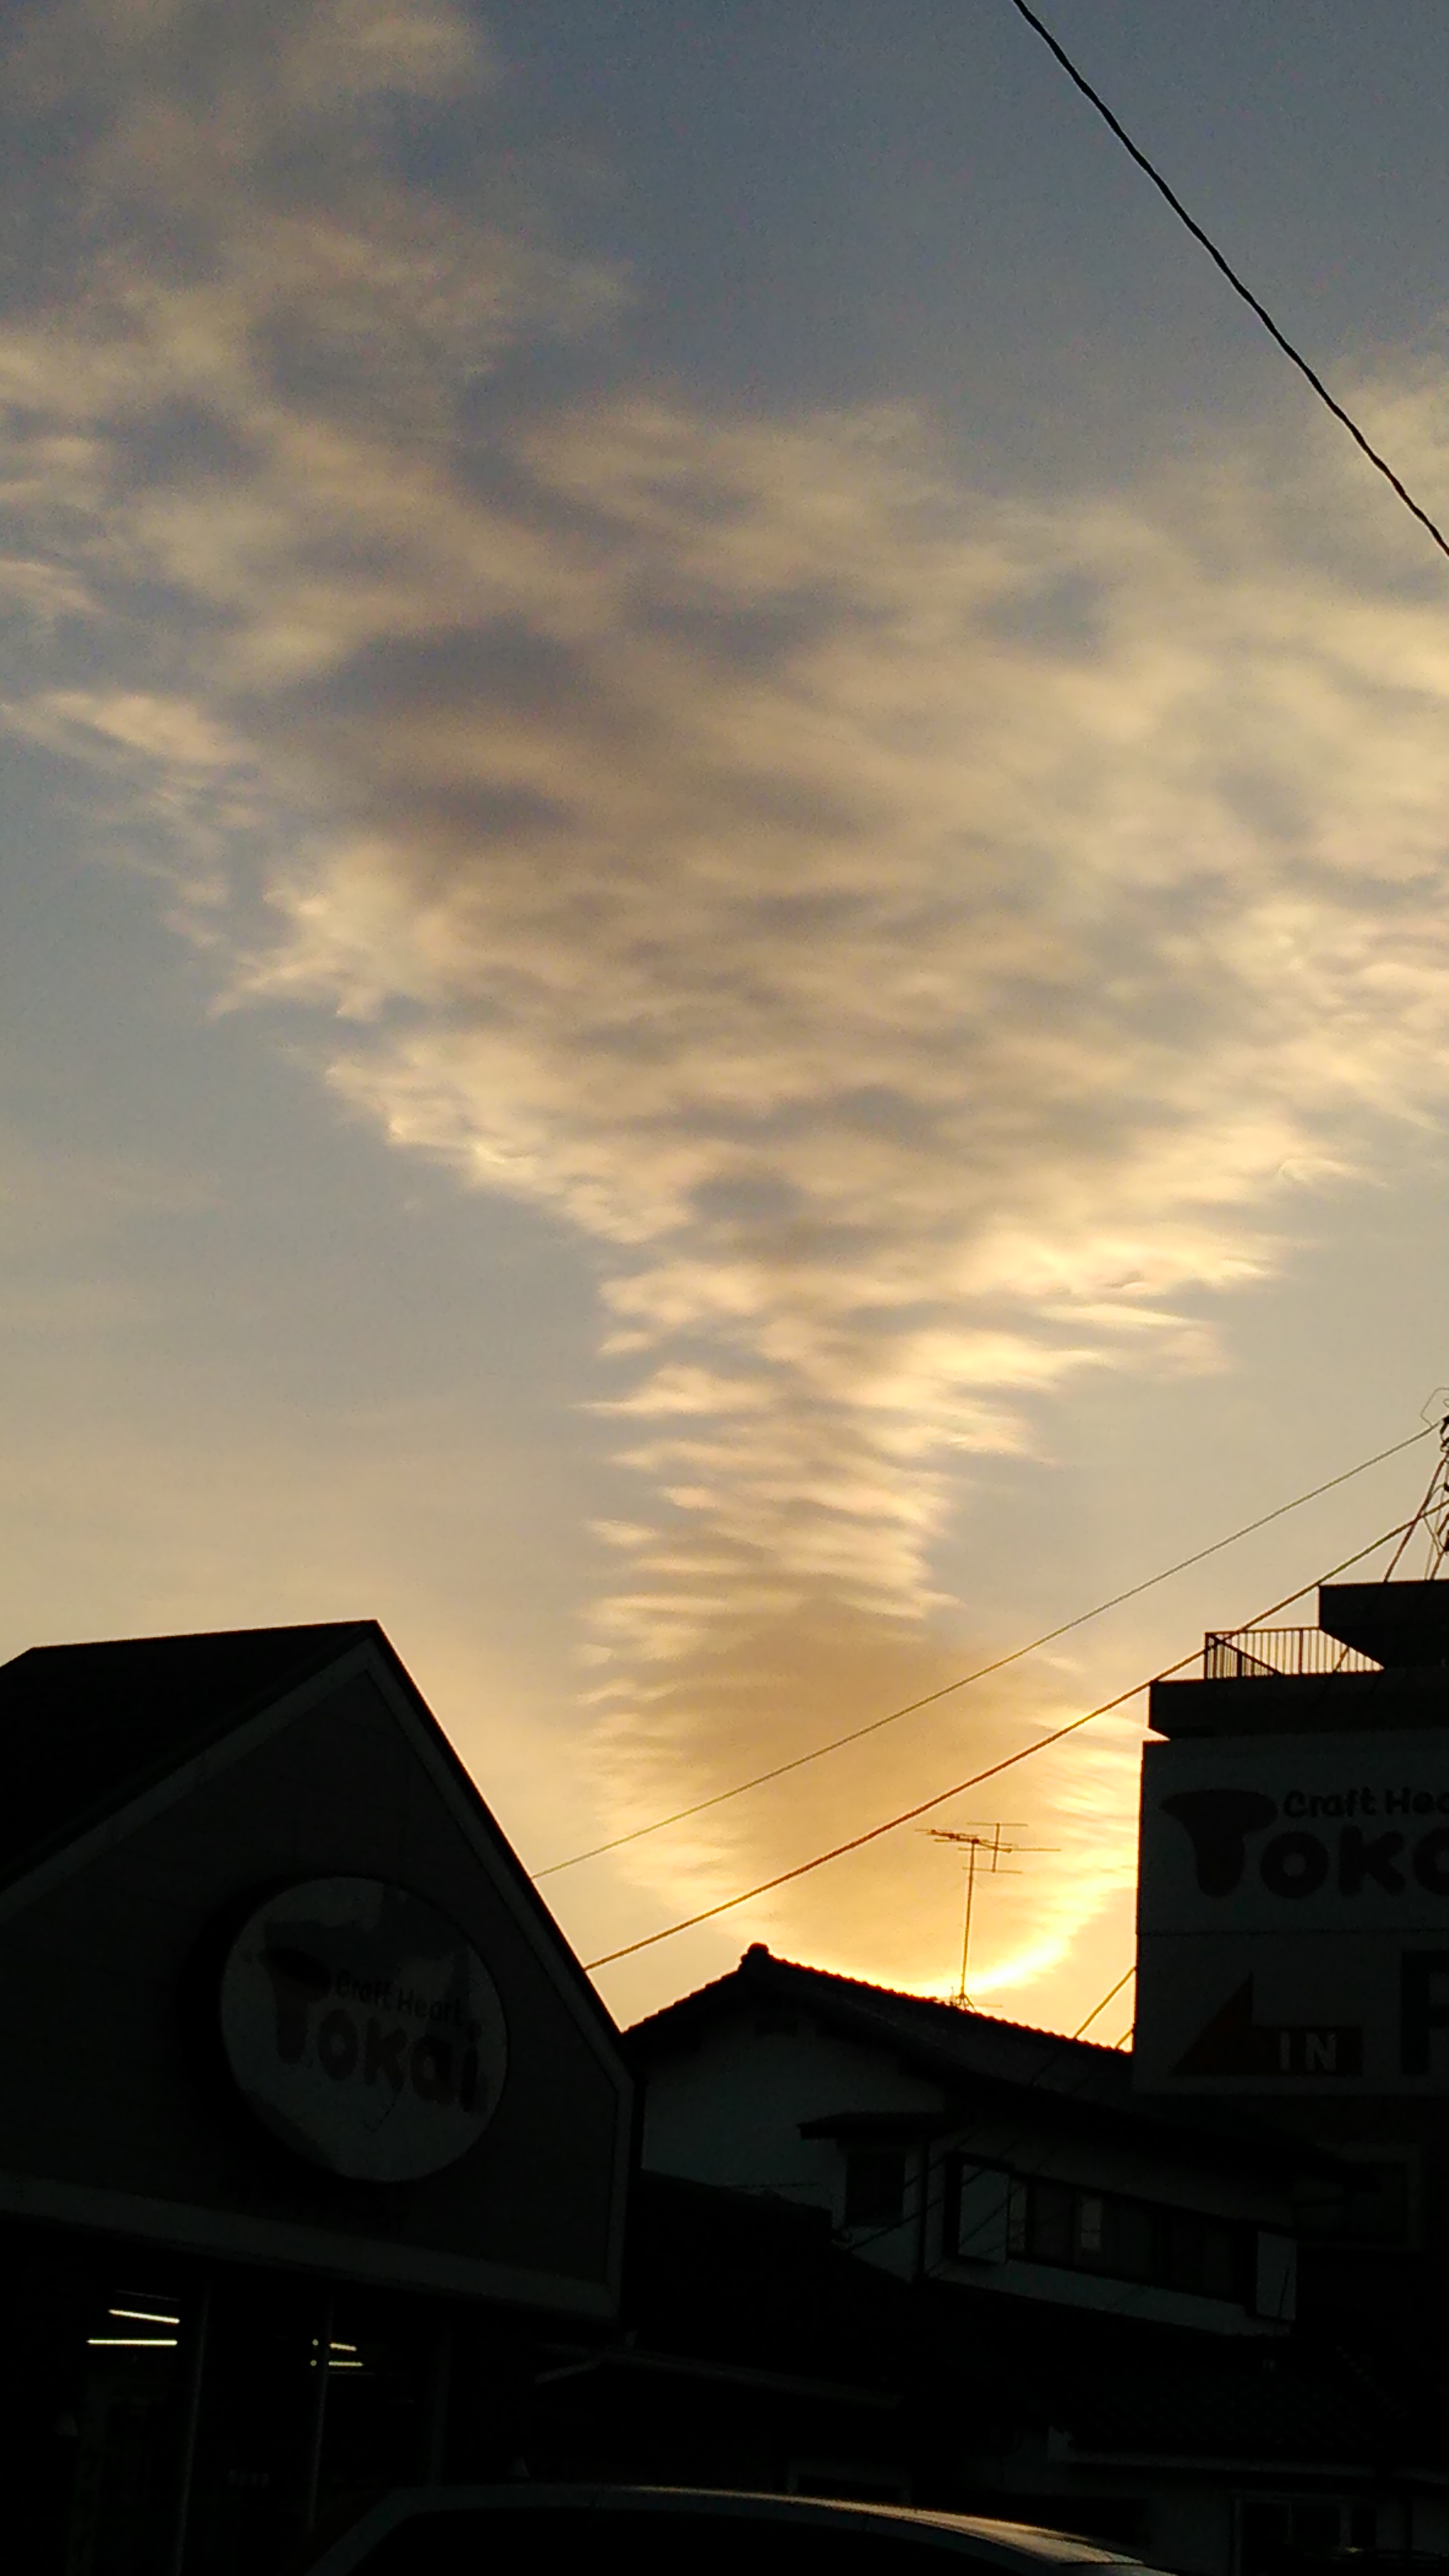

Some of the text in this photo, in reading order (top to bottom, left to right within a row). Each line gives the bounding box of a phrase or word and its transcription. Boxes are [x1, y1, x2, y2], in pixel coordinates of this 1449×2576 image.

[1284, 1787, 1376, 1817] Craft
[398, 1990, 463, 2027] Heart
[1279, 2031, 1336, 2071] IN
